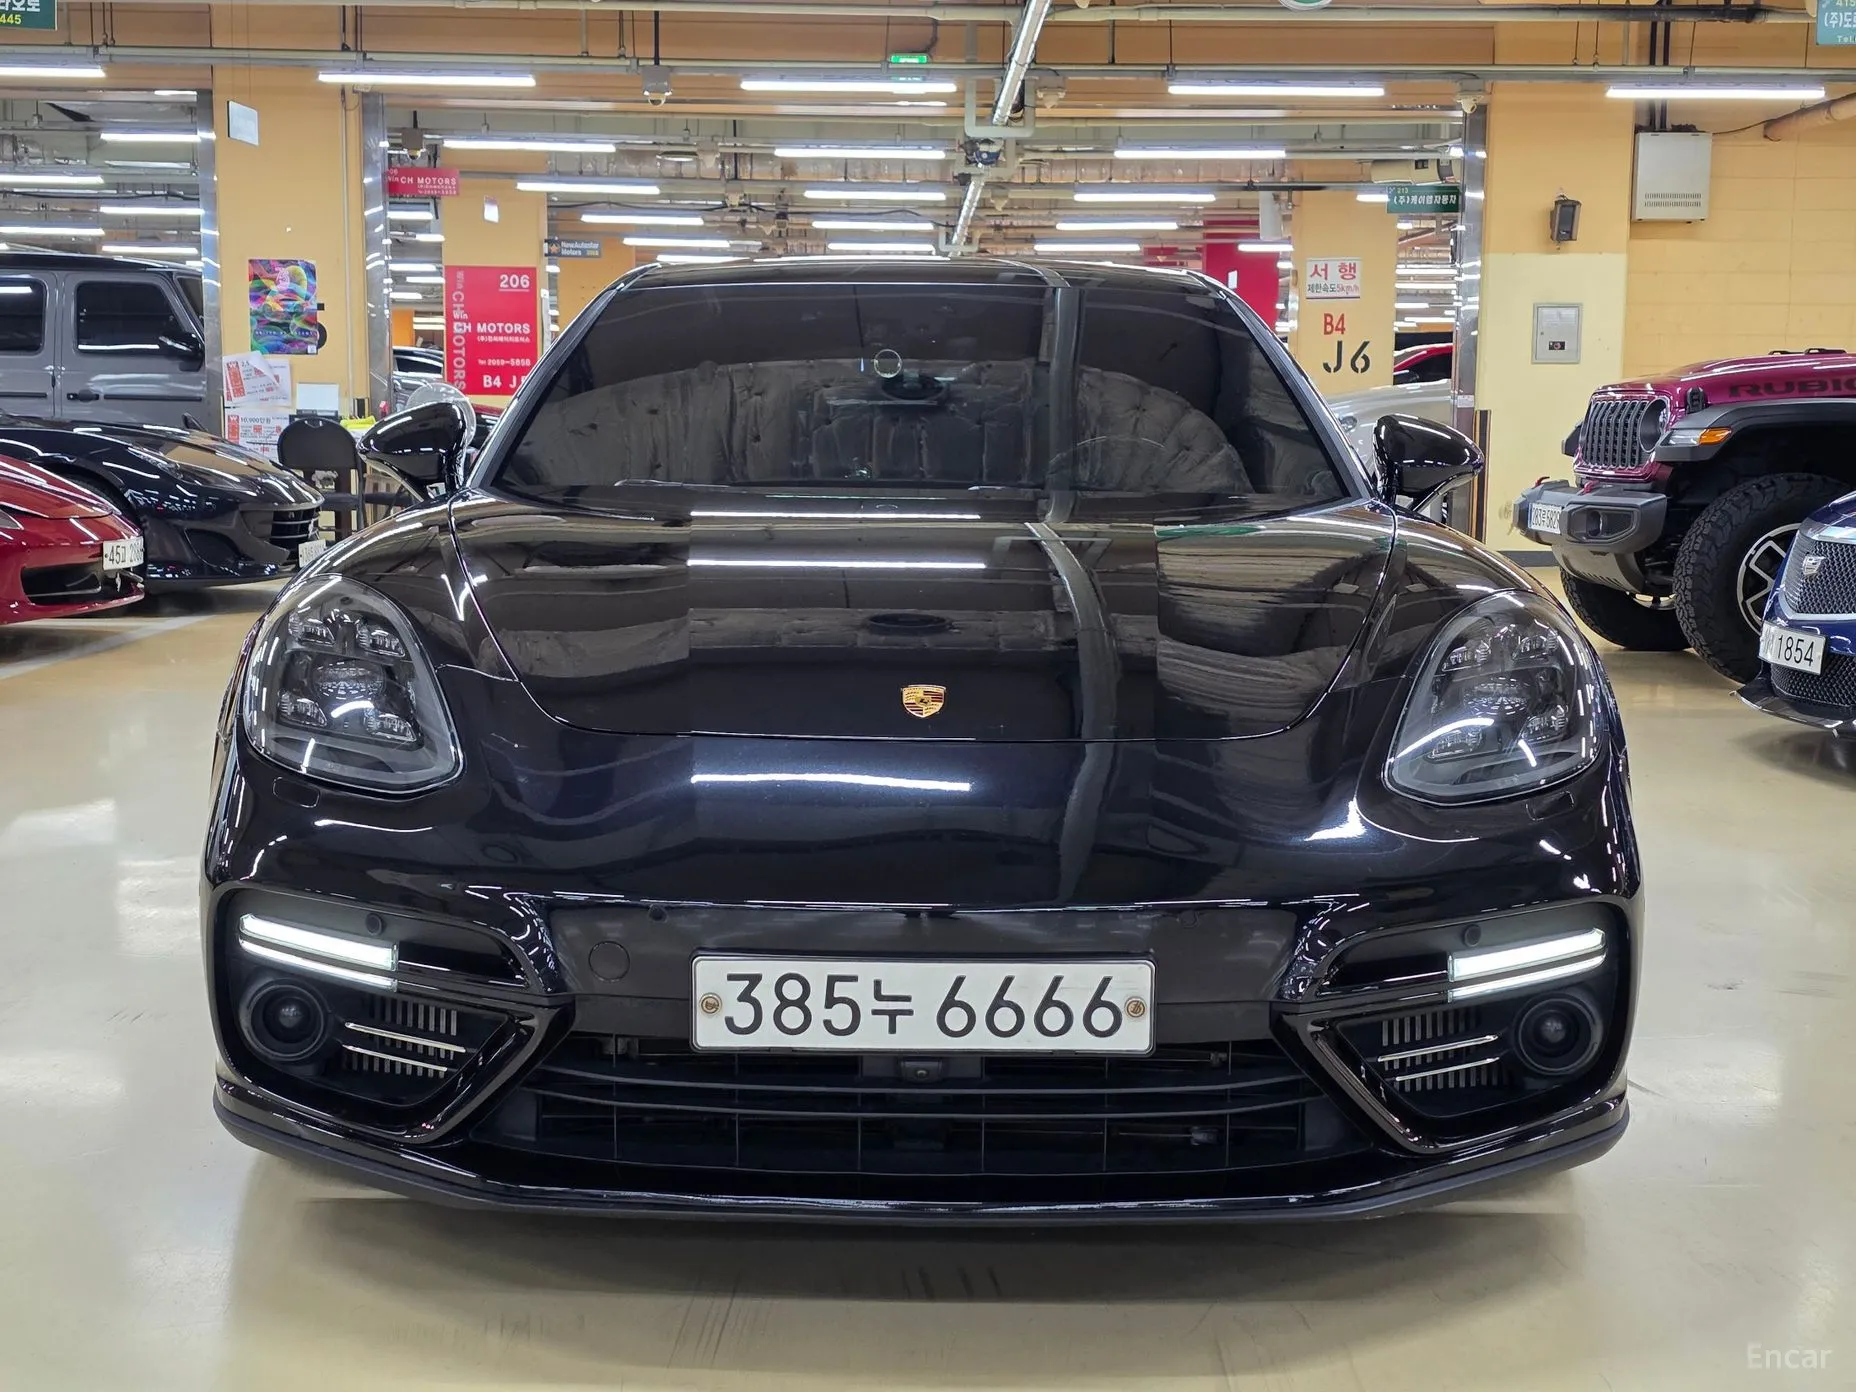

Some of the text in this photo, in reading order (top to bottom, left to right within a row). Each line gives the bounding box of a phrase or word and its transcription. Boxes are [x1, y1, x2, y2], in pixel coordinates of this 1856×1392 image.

[400, 176, 414, 184] CH
[417, 177, 456, 185] MOTORS
[499, 274, 530, 289] 206
[477, 322, 530, 334] MOTORS
[1323, 312, 1346, 336] B4
[482, 374, 502, 389] B4
[1777, 634, 1815, 668] 1854
[725, 973, 1123, 1039] 385누 6666
